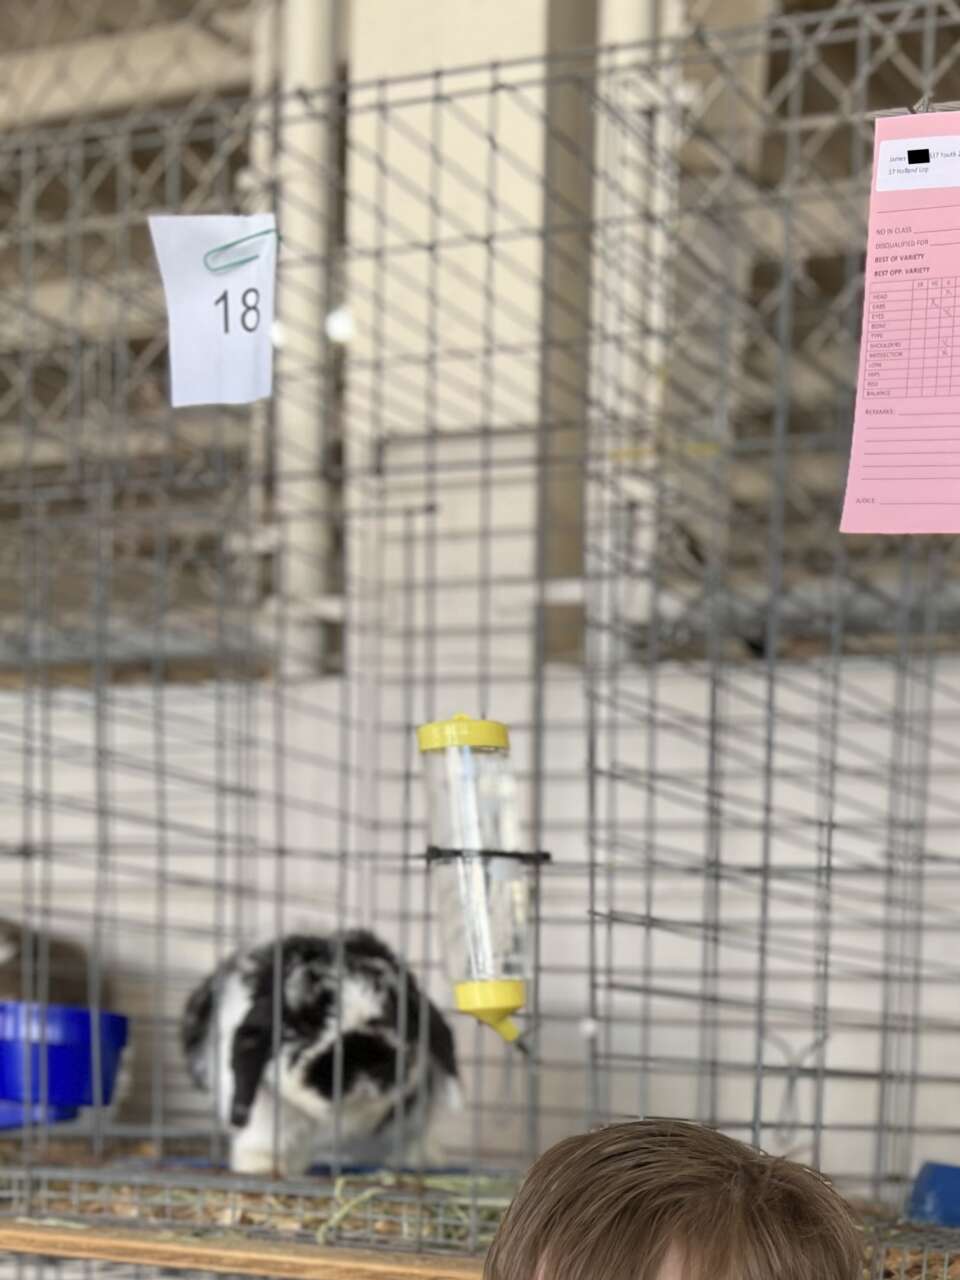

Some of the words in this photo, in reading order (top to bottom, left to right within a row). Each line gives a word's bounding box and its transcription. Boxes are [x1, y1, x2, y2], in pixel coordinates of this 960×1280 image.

[894, 226, 912, 234] CLASS
[900, 253, 925, 261] VARIETY
[904, 266, 930, 274] VARIETY
[214, 287, 260, 335] 18
